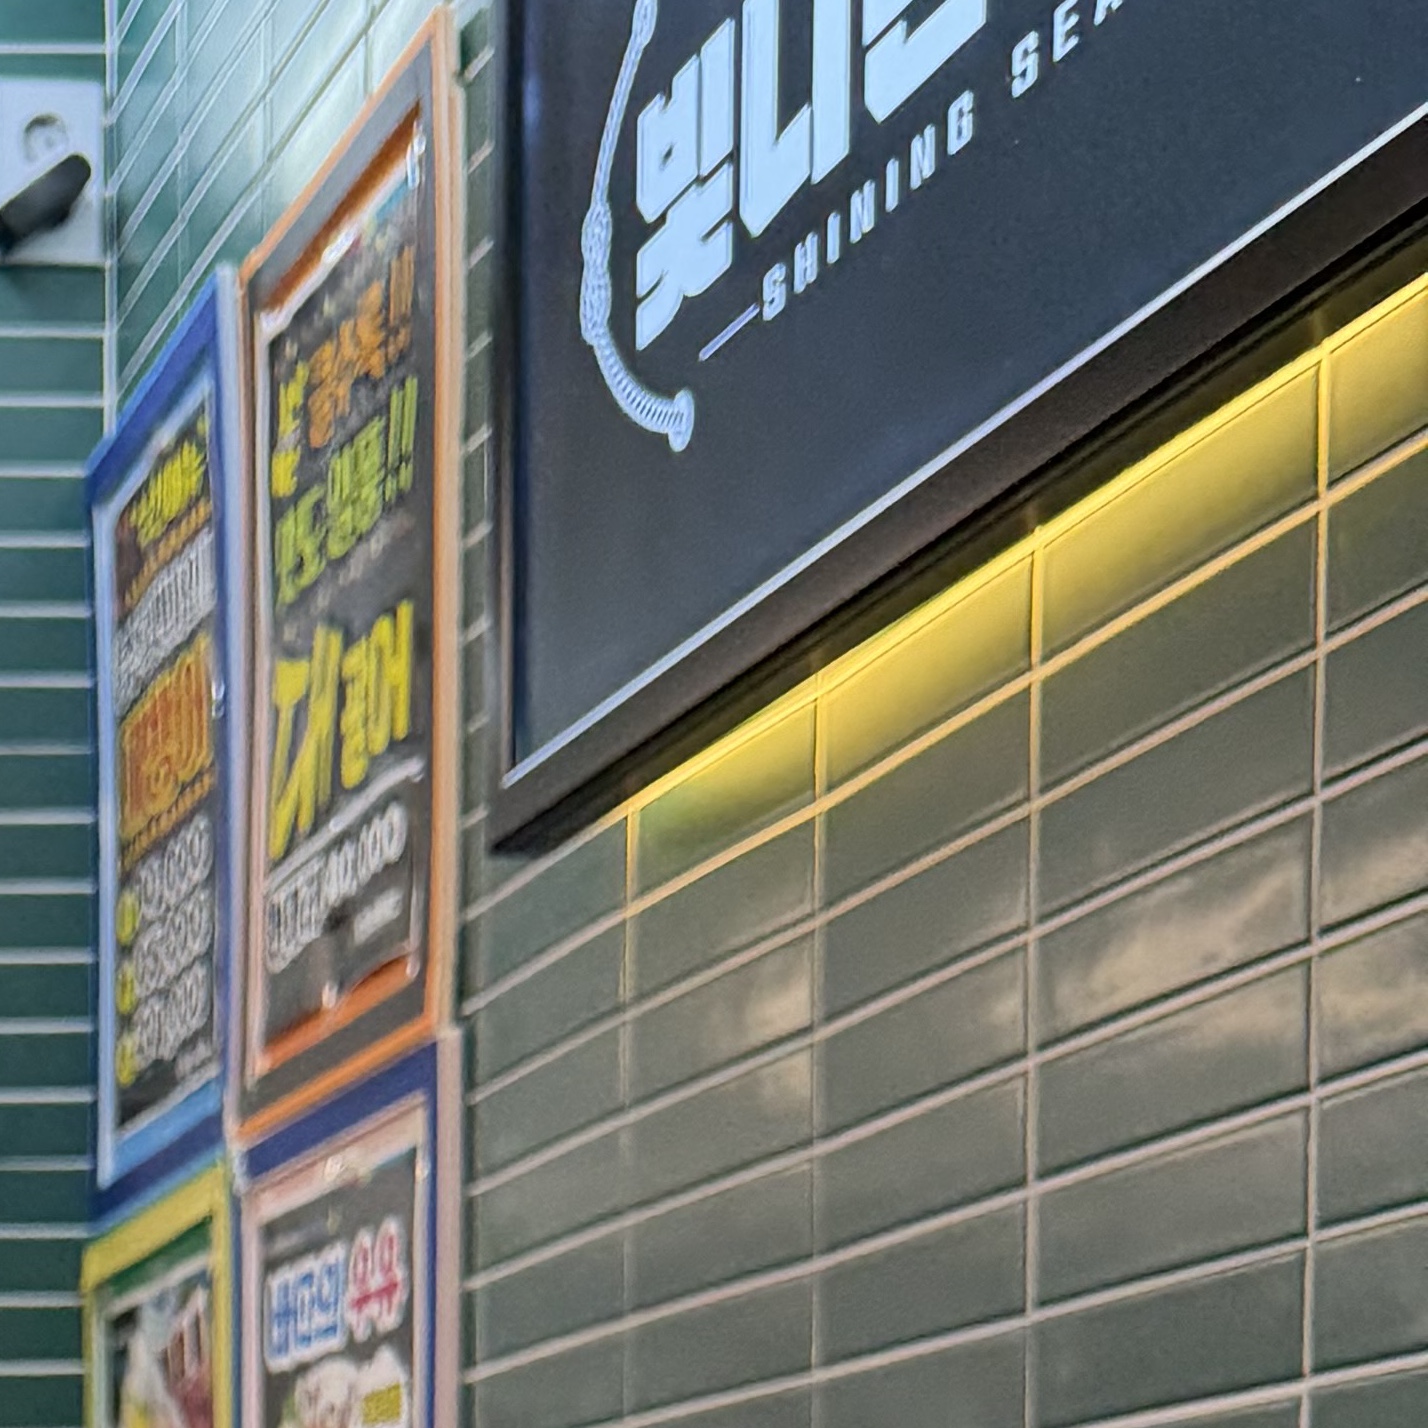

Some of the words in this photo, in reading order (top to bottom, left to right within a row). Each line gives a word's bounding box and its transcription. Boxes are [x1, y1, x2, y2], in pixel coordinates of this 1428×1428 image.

[762, 89, 974, 322] SHINING
[269, 1252, 344, 1366] 바다의
[347, 1225, 403, 1334] 우유
